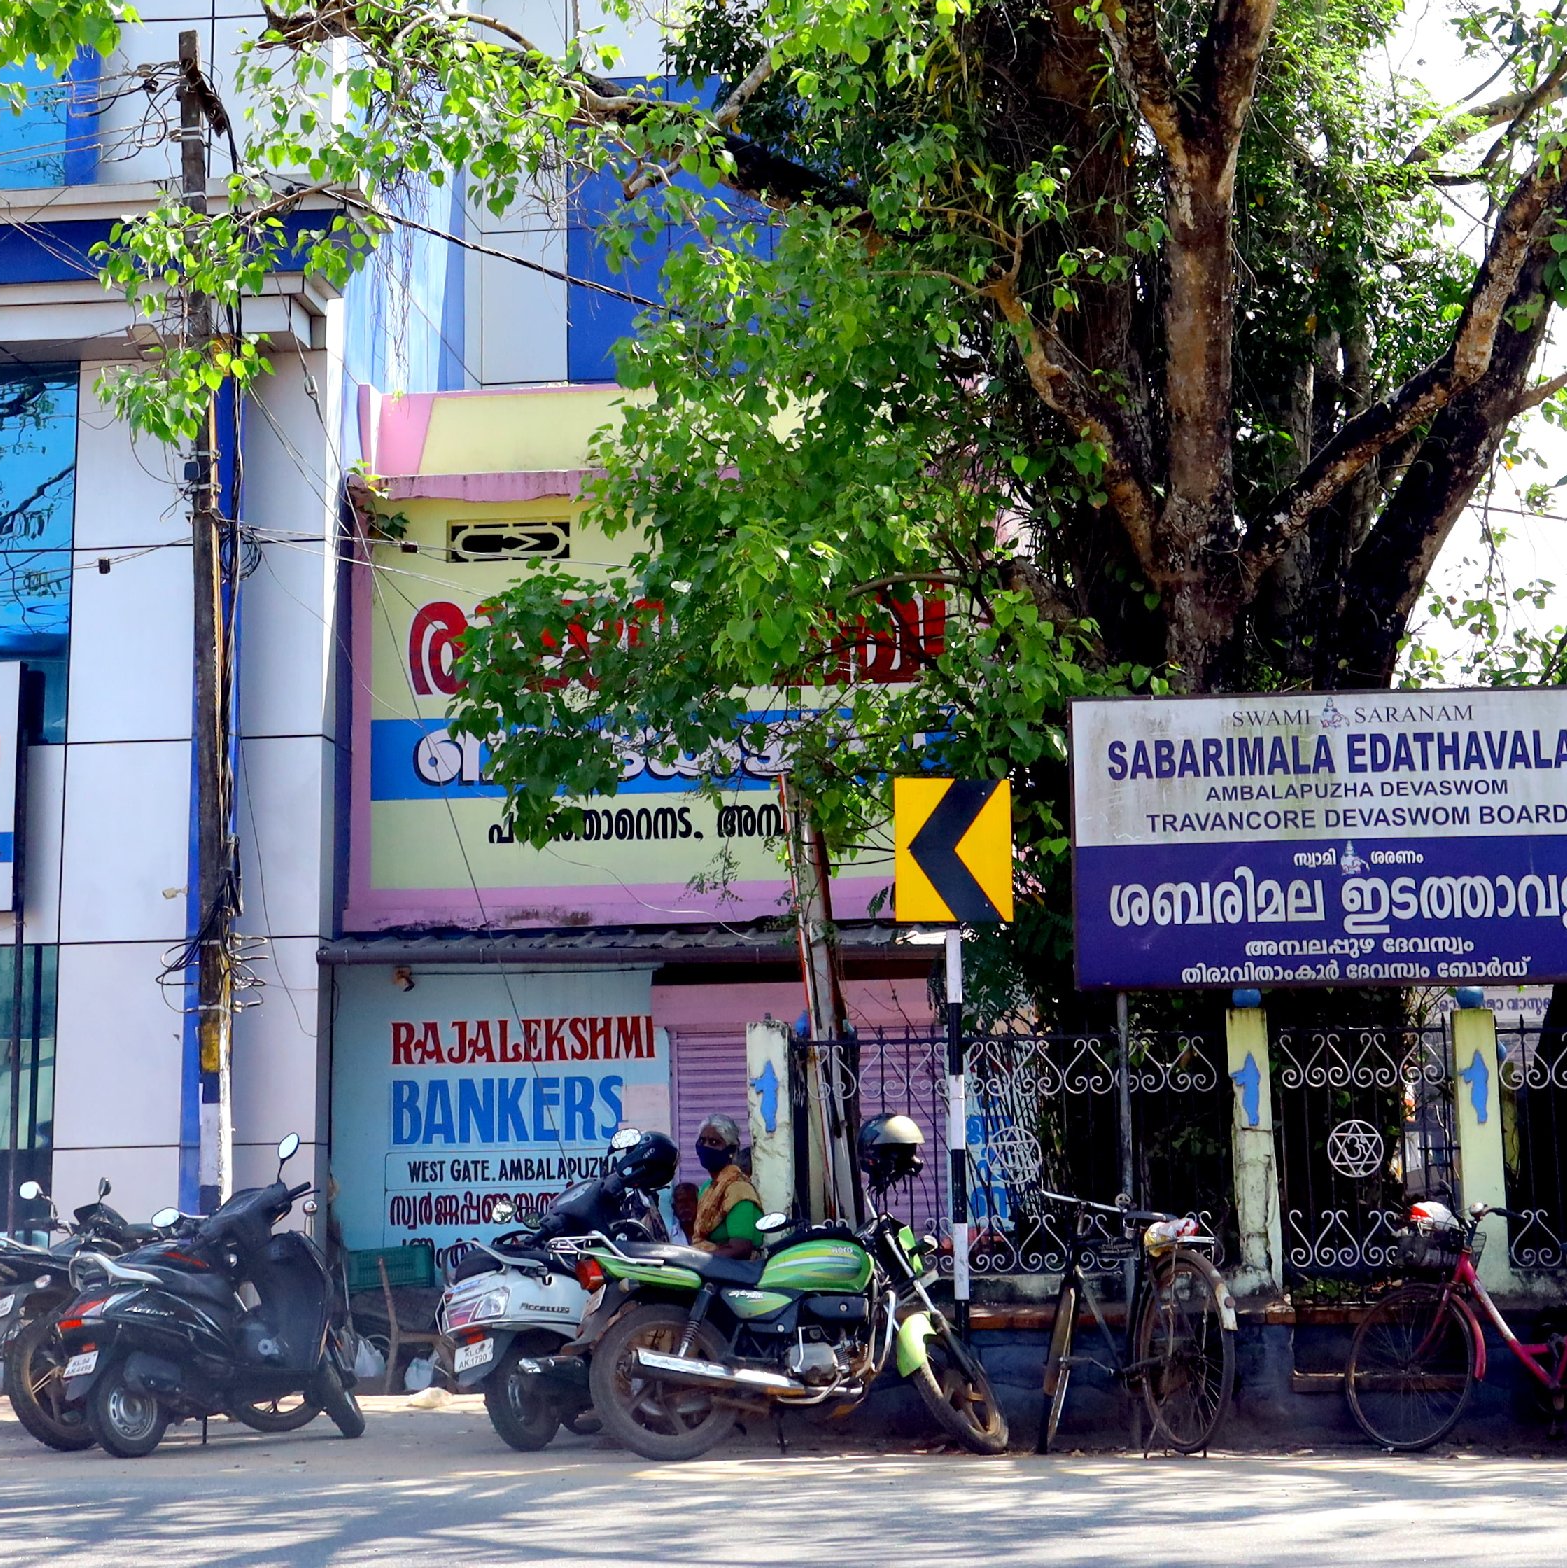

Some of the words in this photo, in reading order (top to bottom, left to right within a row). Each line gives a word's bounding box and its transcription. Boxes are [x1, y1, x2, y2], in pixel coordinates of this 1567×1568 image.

[1232, 709, 1311, 727] SWAMI
[1354, 705, 1474, 723] SARANAM
[1108, 734, 1336, 780] SABARIMALA
[1205, 782, 1374, 802] AMBALAPUZHA
[1381, 779, 1509, 797] DEVASWOM
[1146, 810, 1317, 833] TRAVANCORE
[1324, 806, 1471, 830] DEVASWOM
[1293, 848, 1337, 867] സ്വാമി
[1370, 850, 1424, 865] ശരണം
[1109, 866, 1326, 928] ശബരിമല
[1245, 936, 1375, 959] അമ്പലപ്പുഴ
[1382, 935, 1474, 955] ദേവസ്വം
[1346, 962, 1430, 979] ദേവസ്വം
[1437, 956, 1532, 978] ബോർഡ്
[391, 1016, 656, 1065] RAJALEKSHMI
[392, 1075, 624, 1145] BANKERS
[408, 1160, 446, 1183] WEST
